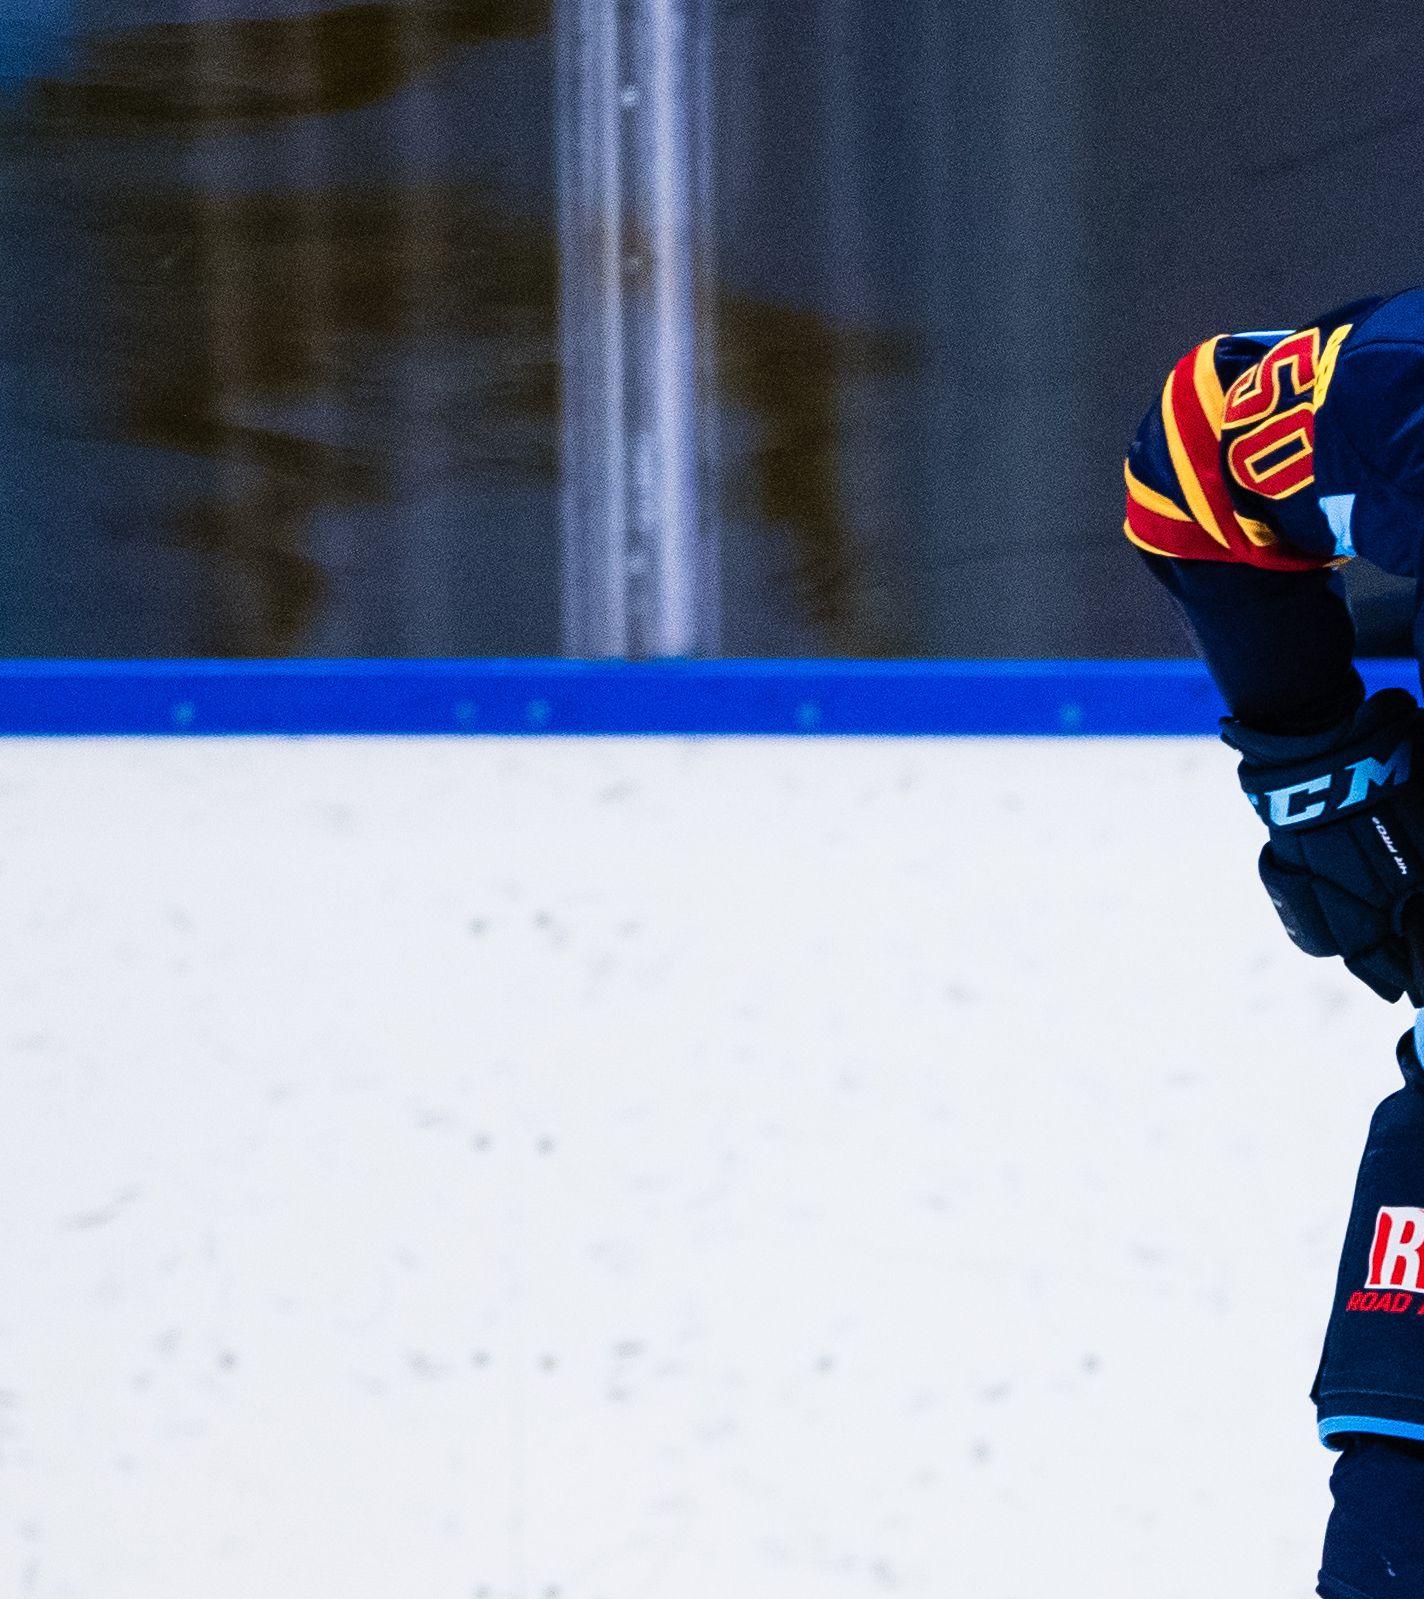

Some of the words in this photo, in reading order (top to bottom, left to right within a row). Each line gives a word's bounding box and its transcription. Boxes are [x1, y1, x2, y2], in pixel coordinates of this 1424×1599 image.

[1221, 326, 1321, 499] 50
[1246, 738, 1412, 826] CM
[1345, 1289, 1413, 1313] ROAD
